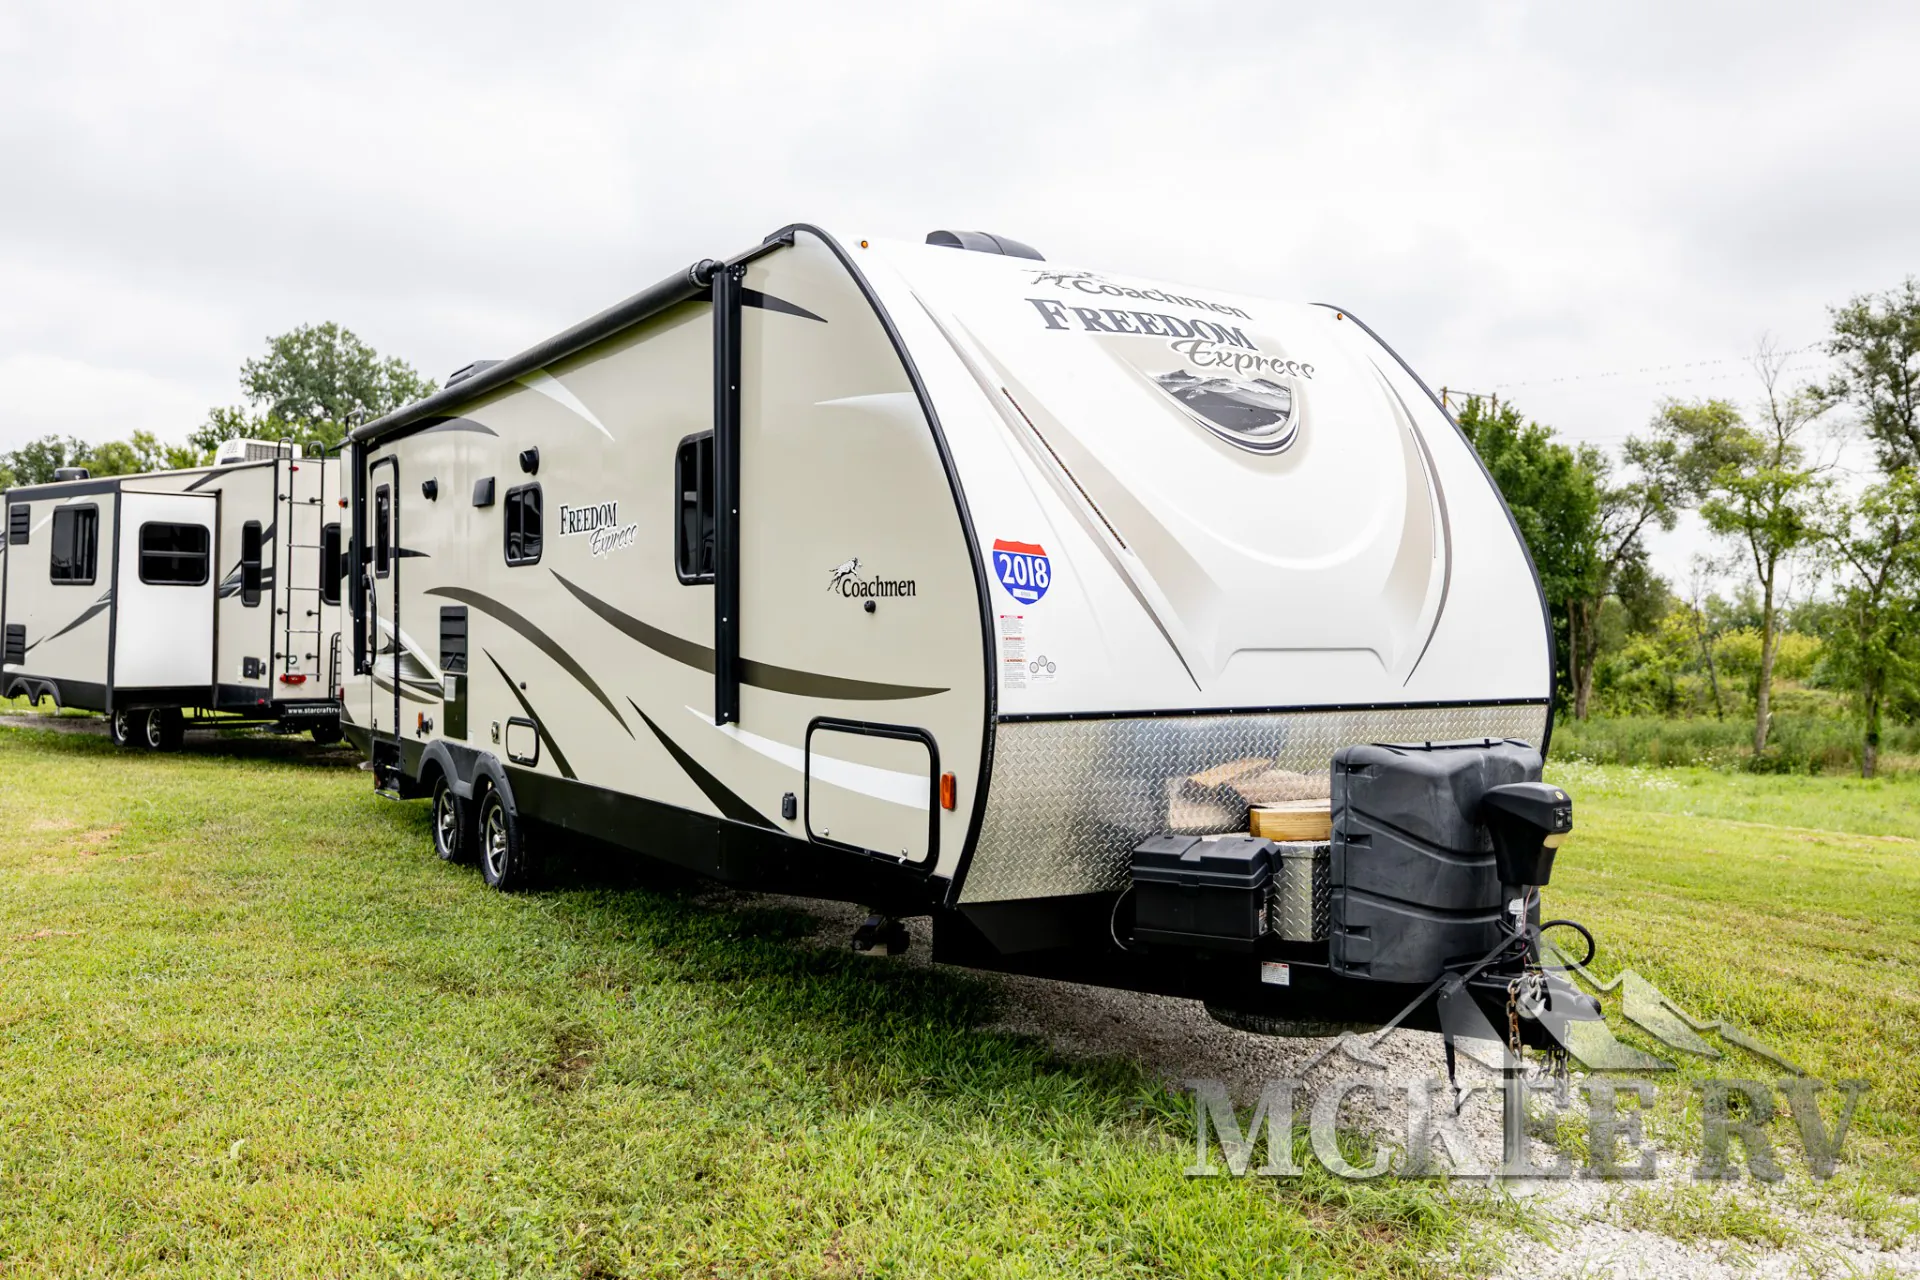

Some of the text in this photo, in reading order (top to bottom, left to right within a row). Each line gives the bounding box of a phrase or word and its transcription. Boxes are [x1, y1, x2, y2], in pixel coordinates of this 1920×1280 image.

[1072, 279, 1252, 320] Coachmen
[1024, 298, 1259, 351] FREEDOM
[1171, 339, 1315, 380] Express
[560, 502, 617, 535] FREEDOM
[589, 525, 637, 555] Express
[842, 575, 916, 597] Coachmen
[999, 553, 1049, 589] 2018
